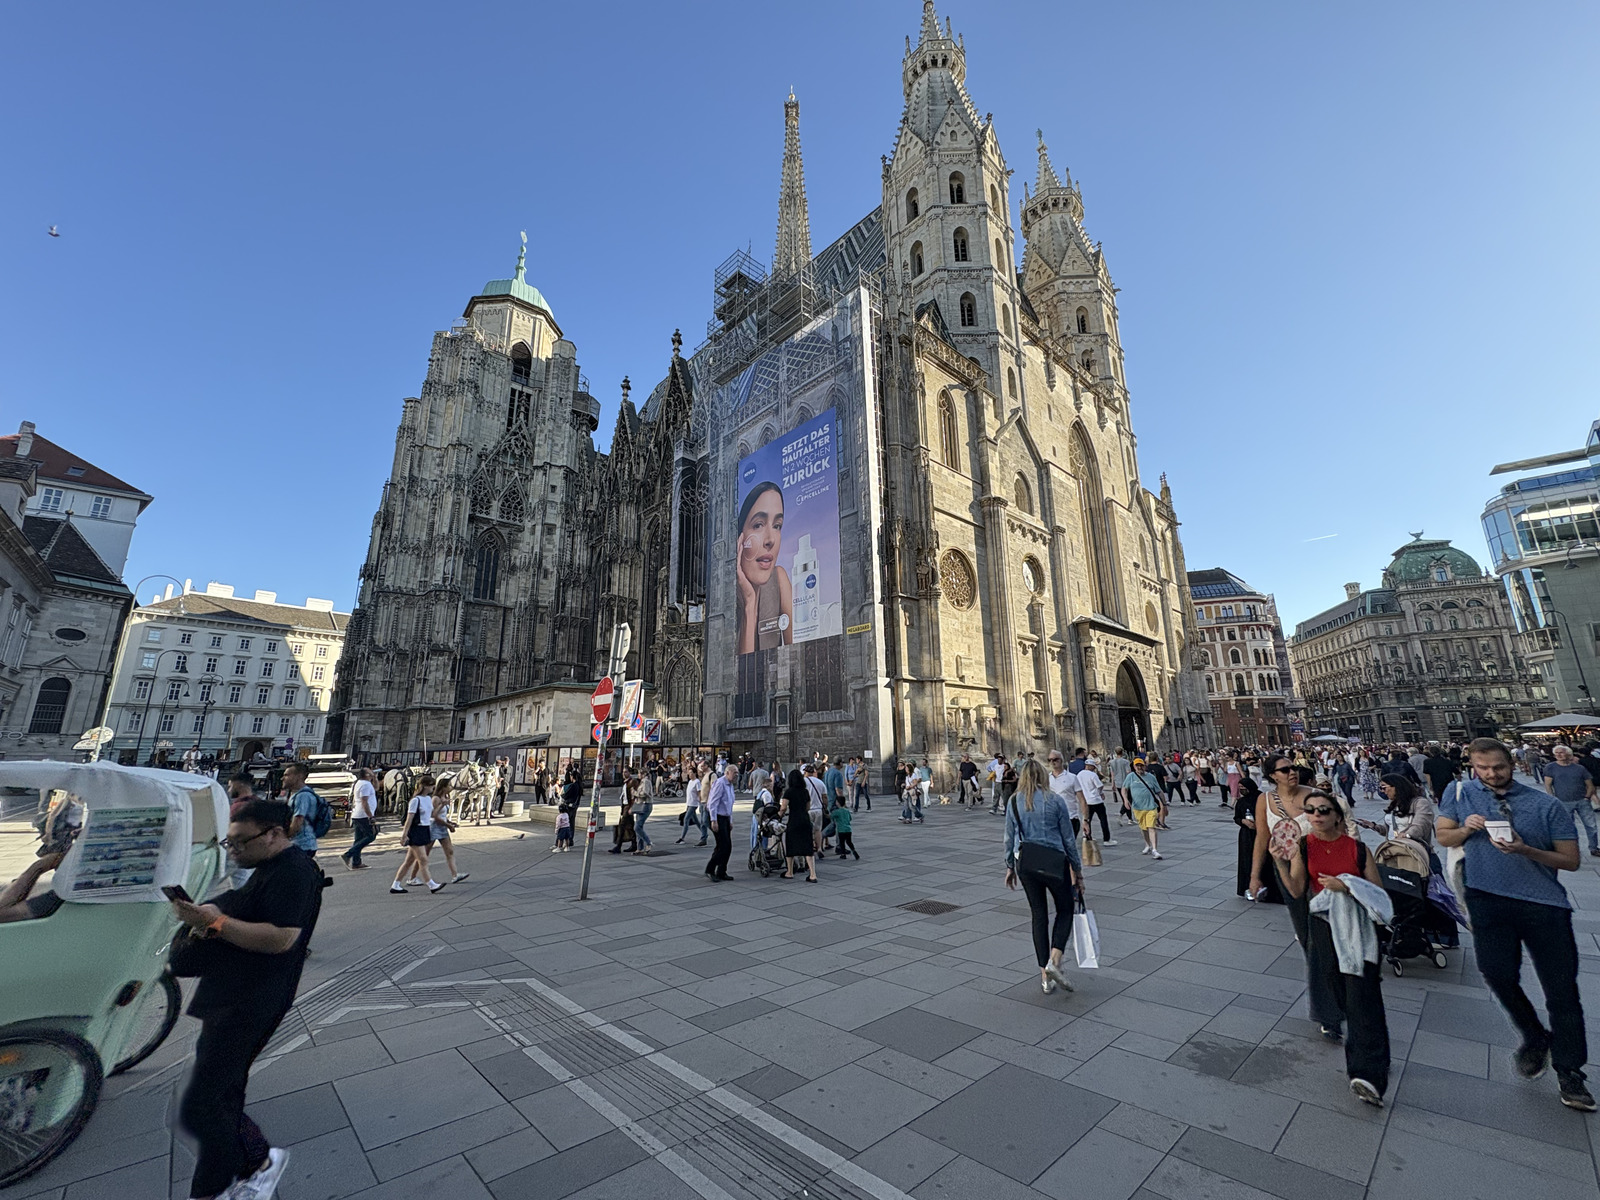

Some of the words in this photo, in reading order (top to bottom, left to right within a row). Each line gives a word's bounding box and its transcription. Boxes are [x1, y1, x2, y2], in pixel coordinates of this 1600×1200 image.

[782, 434, 809, 456] SETZT
[810, 423, 830, 442] DAS
[782, 435, 831, 466] HAUTALTER
[782, 455, 831, 490] ZURÜCK
[783, 466, 790, 475] IN
[791, 462, 795, 471] 2
[796, 444, 831, 468] WOCHEN
